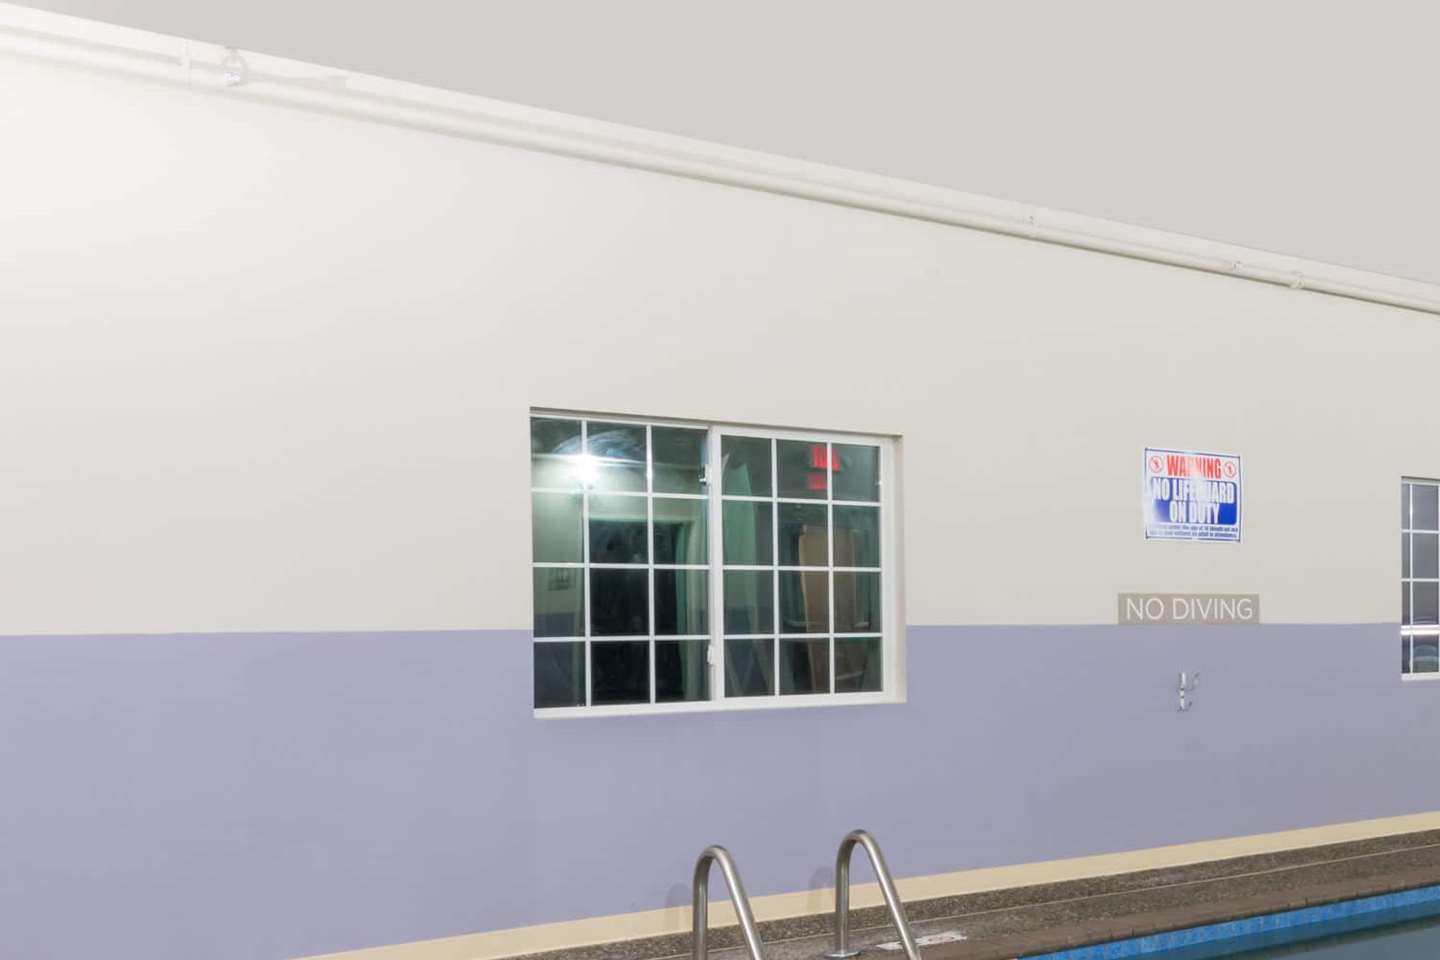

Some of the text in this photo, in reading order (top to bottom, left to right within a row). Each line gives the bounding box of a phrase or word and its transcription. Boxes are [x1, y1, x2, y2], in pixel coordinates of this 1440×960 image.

[1152, 477, 1234, 503] NO LIFEARD
[1170, 500, 1220, 524] ON DUTY
[1126, 598, 1253, 620] NO DIVING
